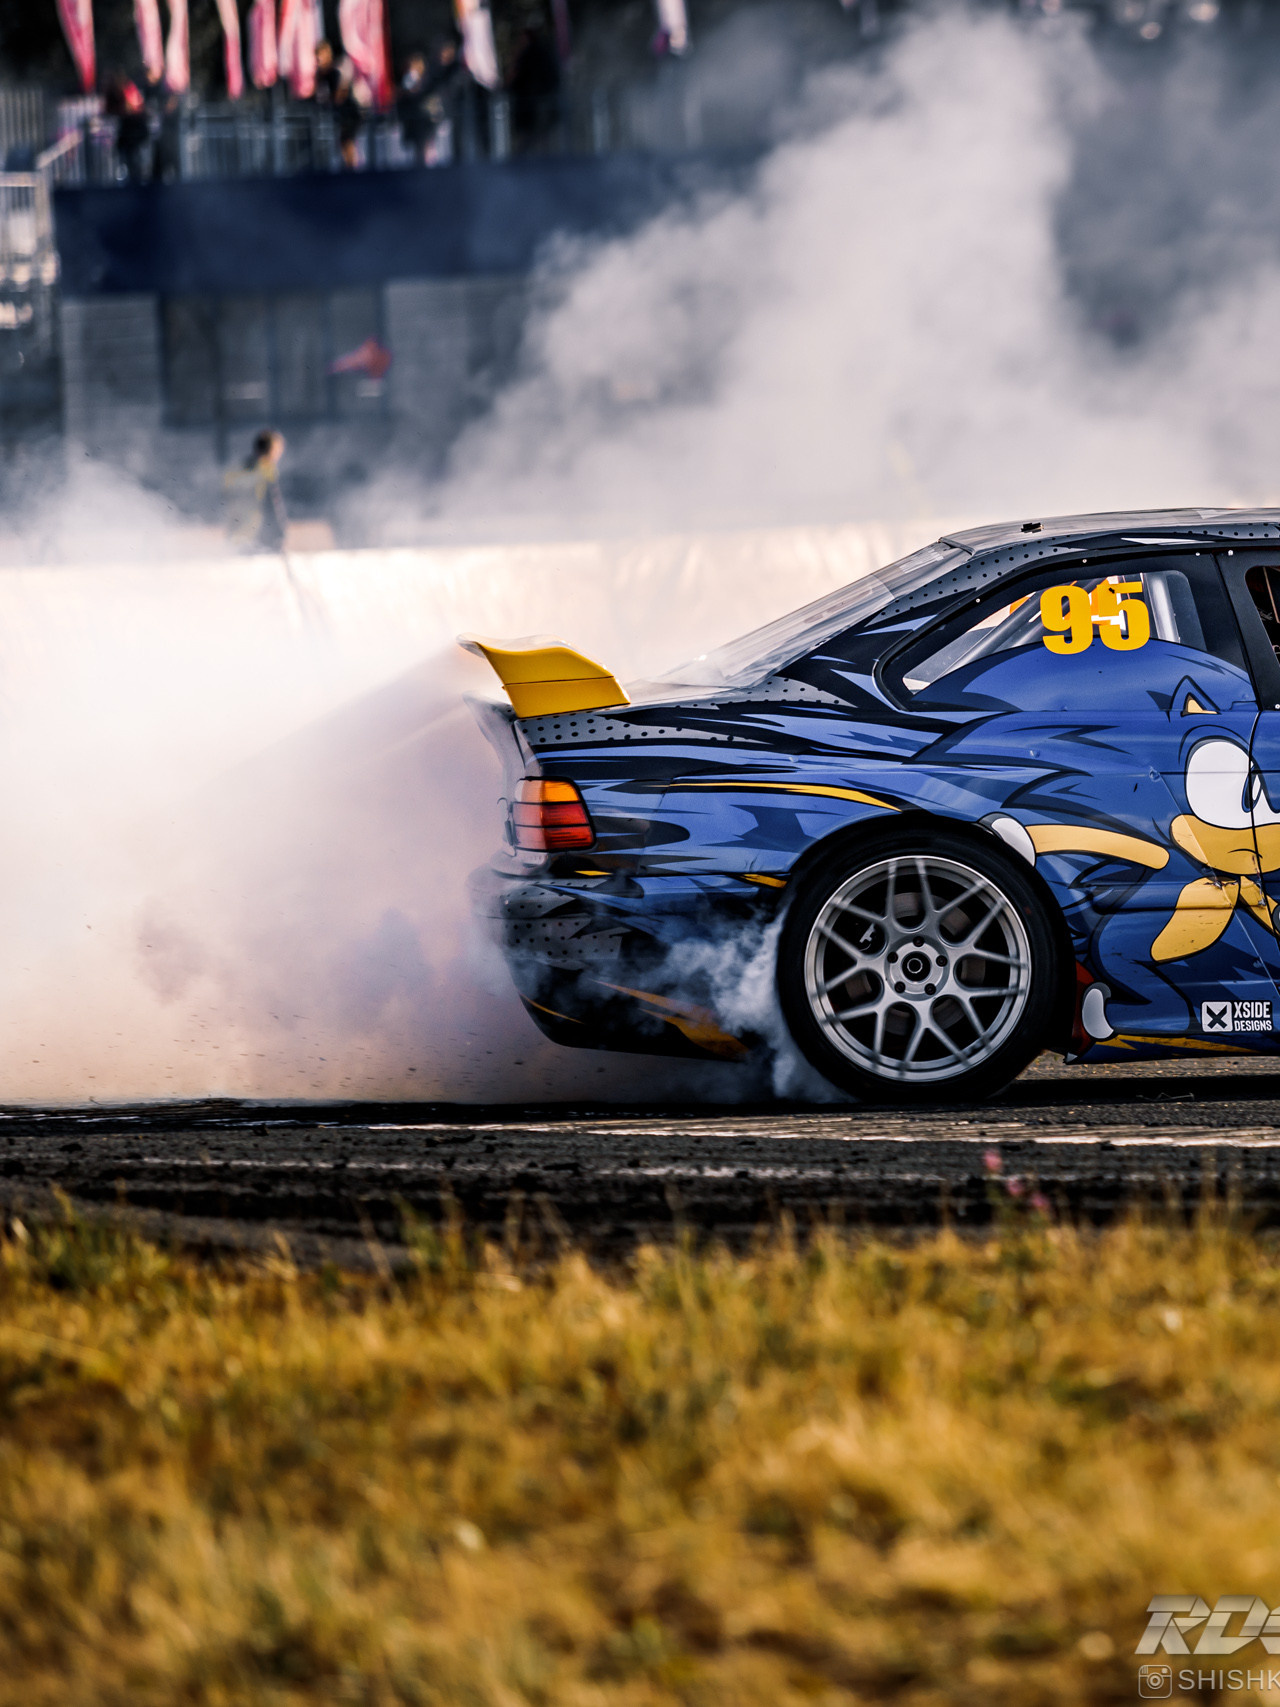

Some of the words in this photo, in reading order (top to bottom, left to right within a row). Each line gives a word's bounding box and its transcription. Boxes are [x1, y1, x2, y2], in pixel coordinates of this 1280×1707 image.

[1040, 582, 1150, 654] 95
[1234, 1001, 1270, 1018] XSIDE
[1234, 1019, 1272, 1032] DESIGNS
